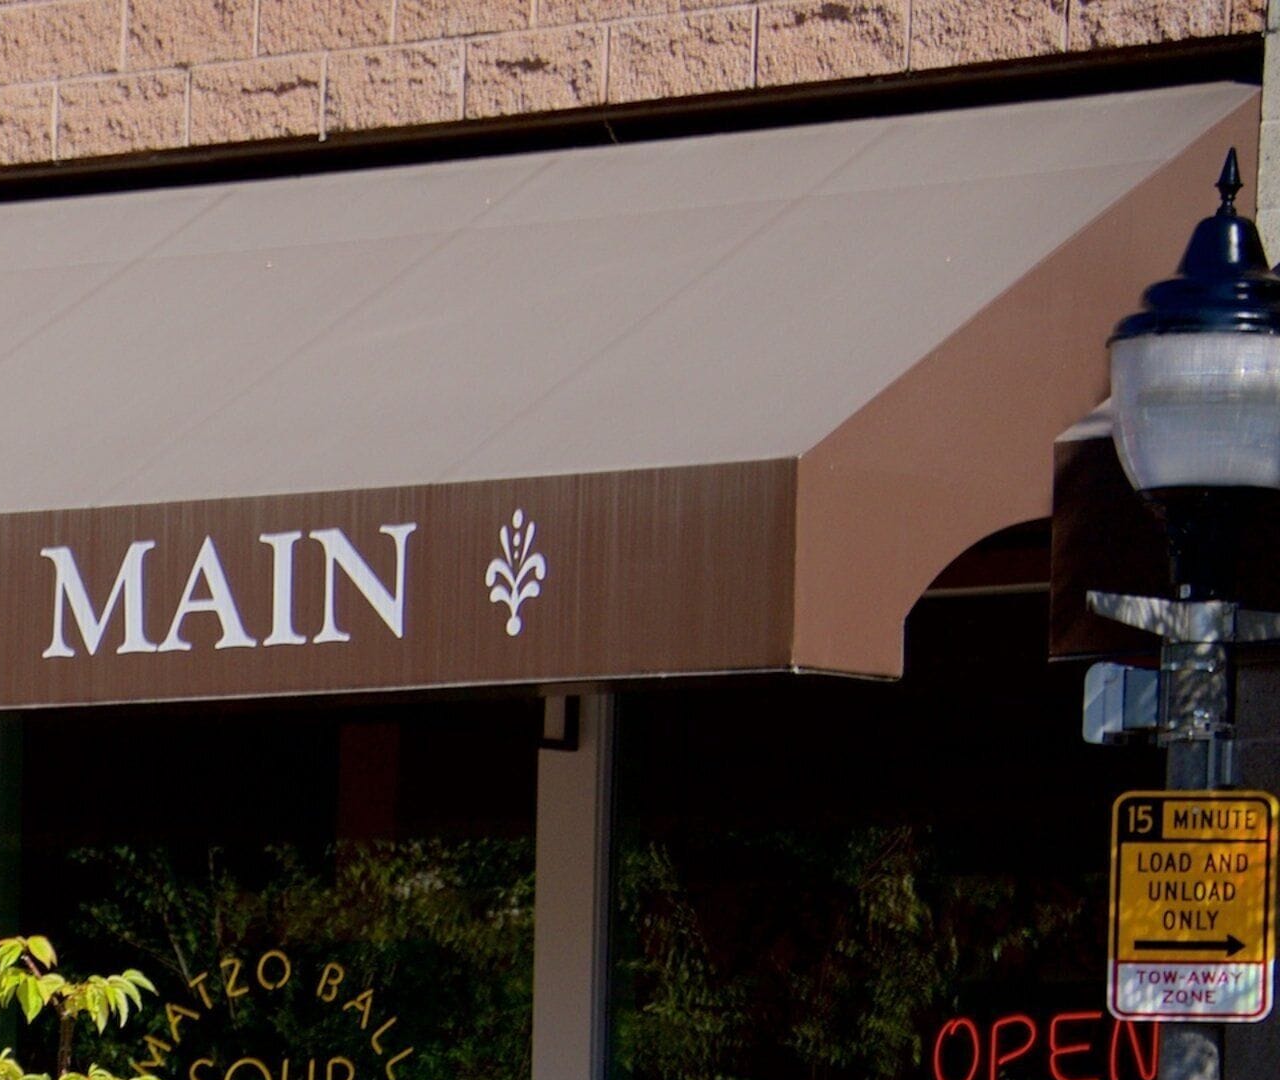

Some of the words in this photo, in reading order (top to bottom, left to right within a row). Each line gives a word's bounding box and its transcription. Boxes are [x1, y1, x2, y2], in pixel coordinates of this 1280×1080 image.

[40, 522, 418, 660] MAIN
[1128, 805, 1153, 833] 15
[1173, 809, 1257, 830] MINUTE
[1137, 852, 1192, 873] LOAD
[1203, 853, 1249, 873] AND
[1147, 881, 1236, 902] UNLOAD
[1162, 910, 1219, 931] ONLY
[1136, 970, 1242, 985] TOW-AWAY
[1162, 990, 1217, 1005] ZONE
[131, 950, 292, 1078] MATZO
